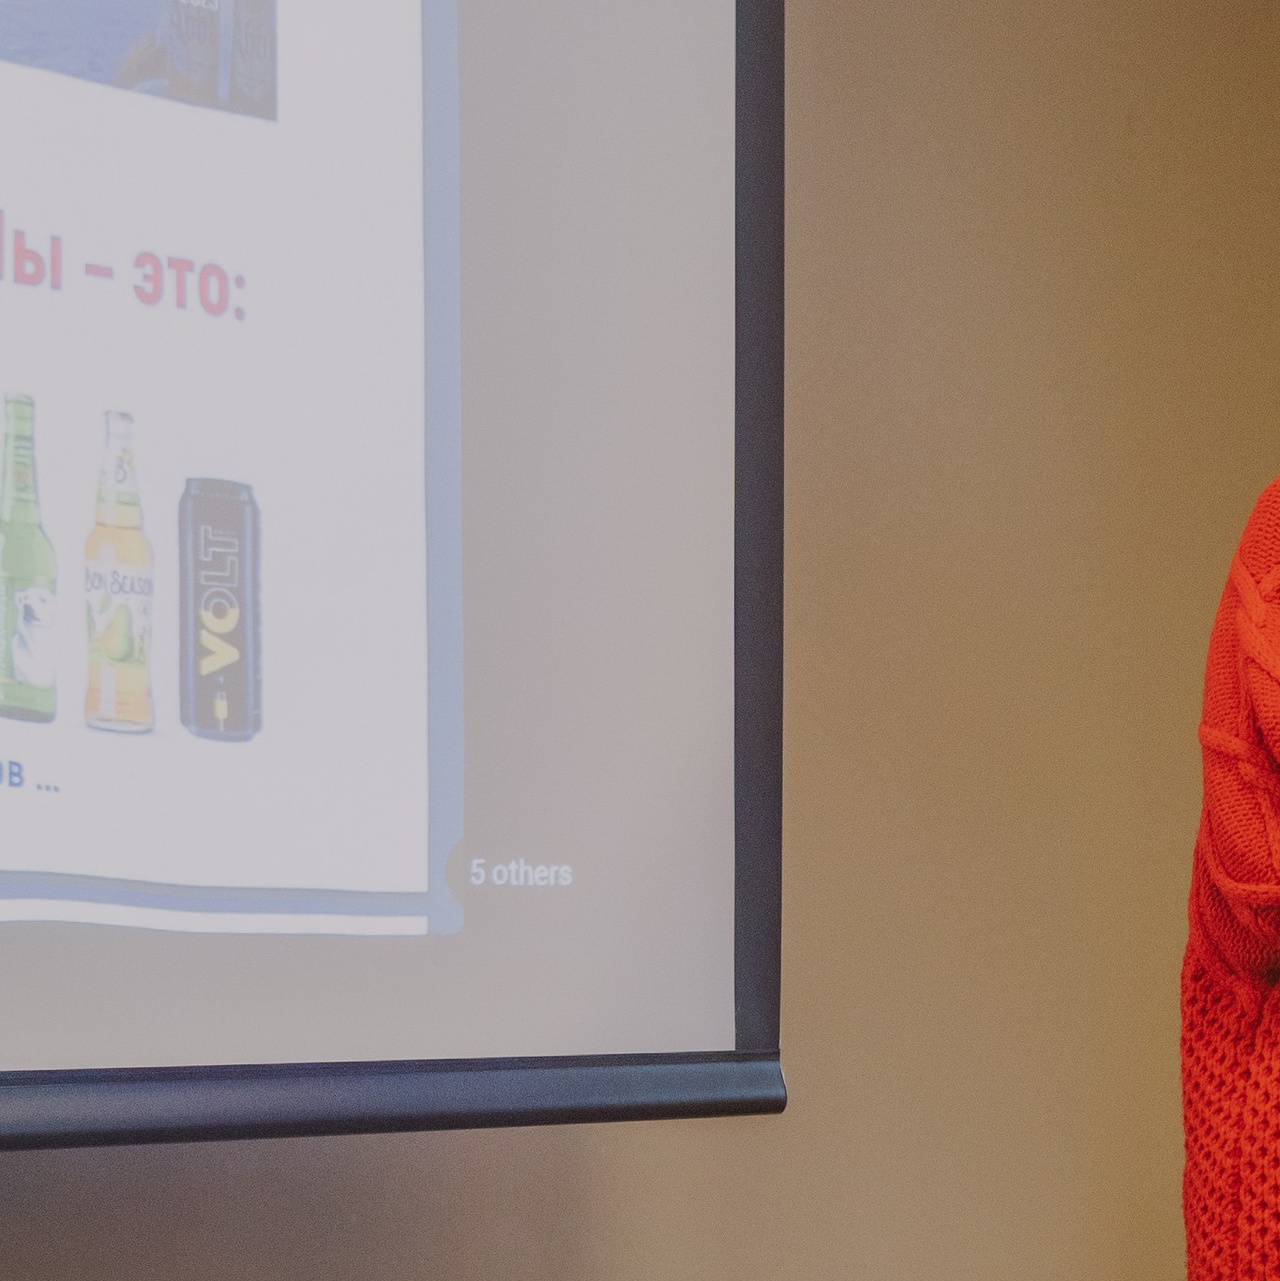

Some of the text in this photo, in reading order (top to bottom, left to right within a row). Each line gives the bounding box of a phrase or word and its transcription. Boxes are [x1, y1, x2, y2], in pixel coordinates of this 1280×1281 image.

[198, 525, 240, 677] VOLT
[469, 857, 573, 886] 5 others
